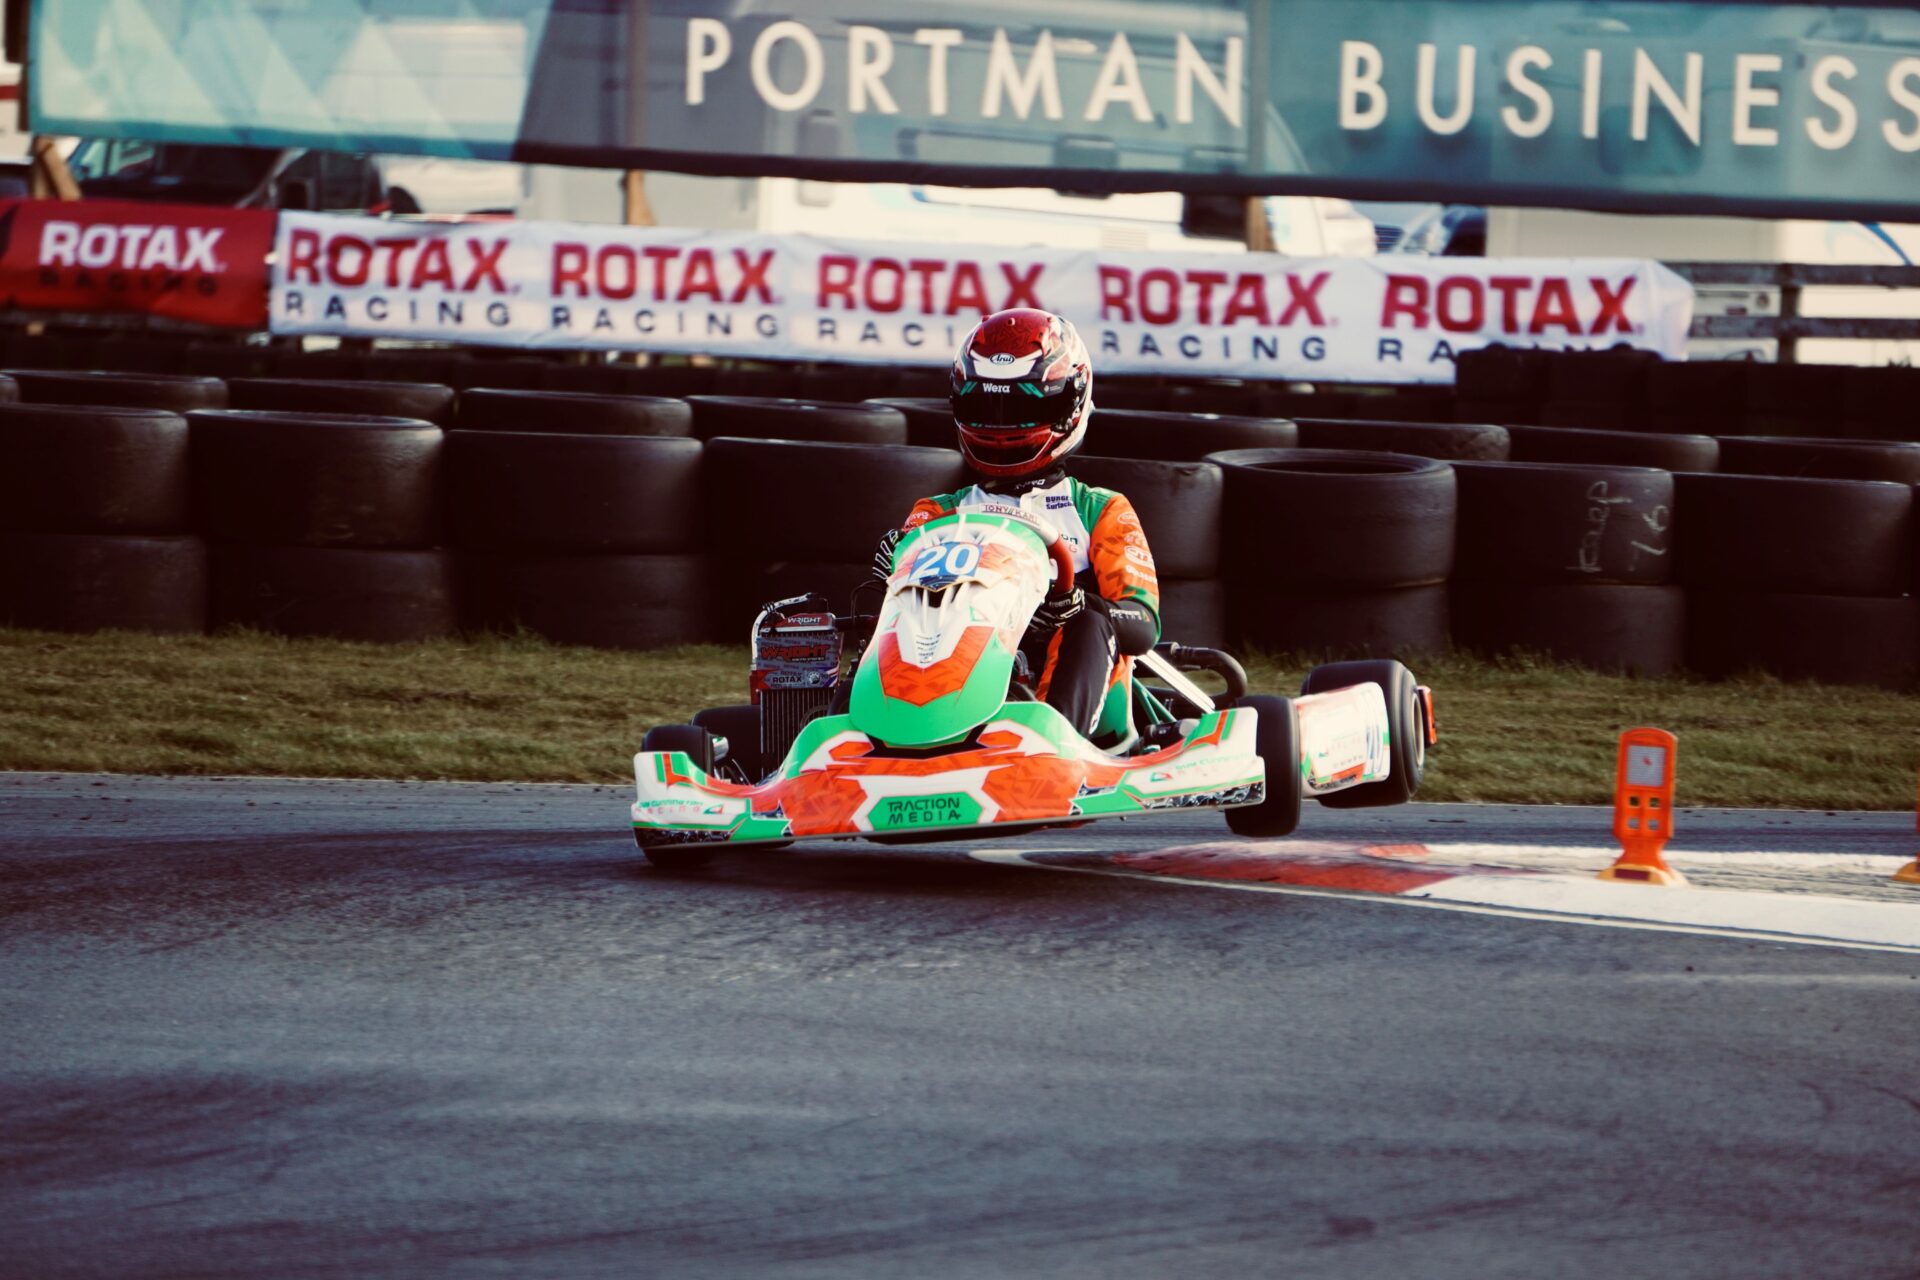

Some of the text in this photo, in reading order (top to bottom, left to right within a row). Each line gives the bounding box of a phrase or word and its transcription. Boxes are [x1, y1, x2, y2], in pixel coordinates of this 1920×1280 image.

[686, 18, 1920, 152] PORTMAN BUSINESS
[39, 221, 225, 272] ROTAX
[286, 229, 513, 293] ROTAX
[552, 243, 776, 304] ROTAX
[818, 255, 1046, 315] ROTAX
[285, 292, 511, 327] RACING
[1098, 265, 1331, 327] ROTAX
[1380, 274, 1638, 336] ROTAX
[552, 306, 778, 338] RACING
[818, 317, 954, 348] RACI
[1101, 330, 1326, 361] RACING
[982, 383, 1010, 393] Wera
[910, 543, 980, 580] 20
[787, 617, 821, 625] WRIGHT
[772, 676, 802, 684] ROTAX
[887, 797, 960, 813] TRACTION
[888, 809, 962, 826] MEDIA
